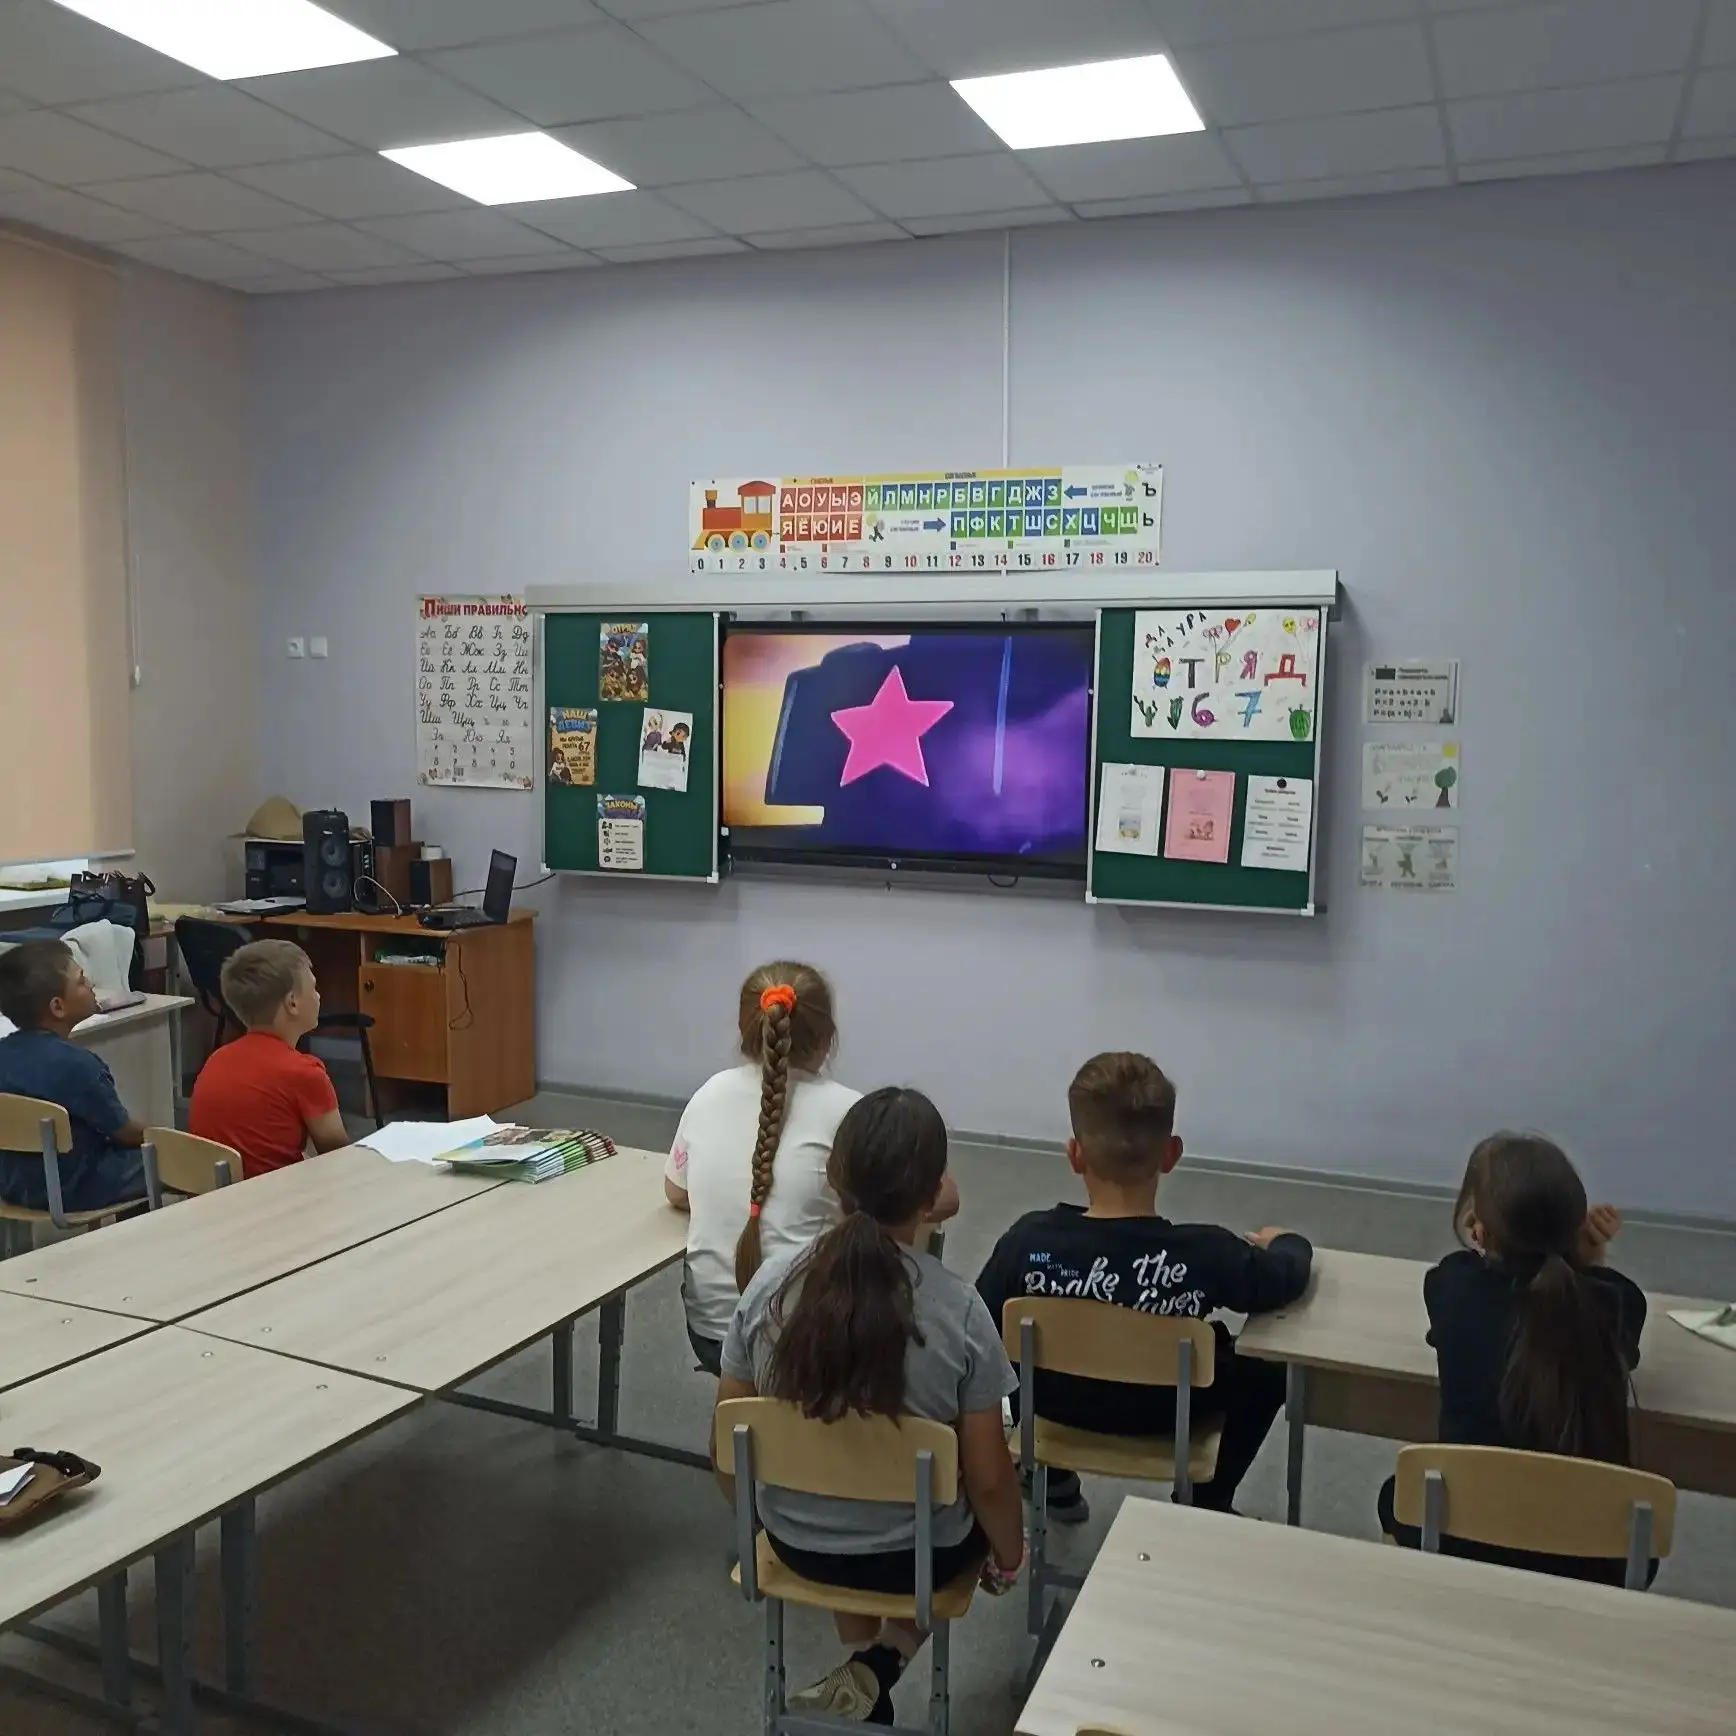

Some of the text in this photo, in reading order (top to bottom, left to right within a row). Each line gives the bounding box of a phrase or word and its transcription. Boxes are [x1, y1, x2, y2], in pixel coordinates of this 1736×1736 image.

[782, 482, 1157, 508] А О У Ы Э Й Л М Н Р Б В Г Д Ж З Ъ
[782, 511, 1154, 535] Я Ё Ю И Е П Ф К Т Ш С Х Ц Ч Щ Ь
[697, 551, 1153, 570] 0 1 2 3 4 5 6 7 8 9 10 11 12 13 14 15 16 17 18 19 20
[1176, 611, 1207, 636] УРА
[578, 741, 590, 751] 67
